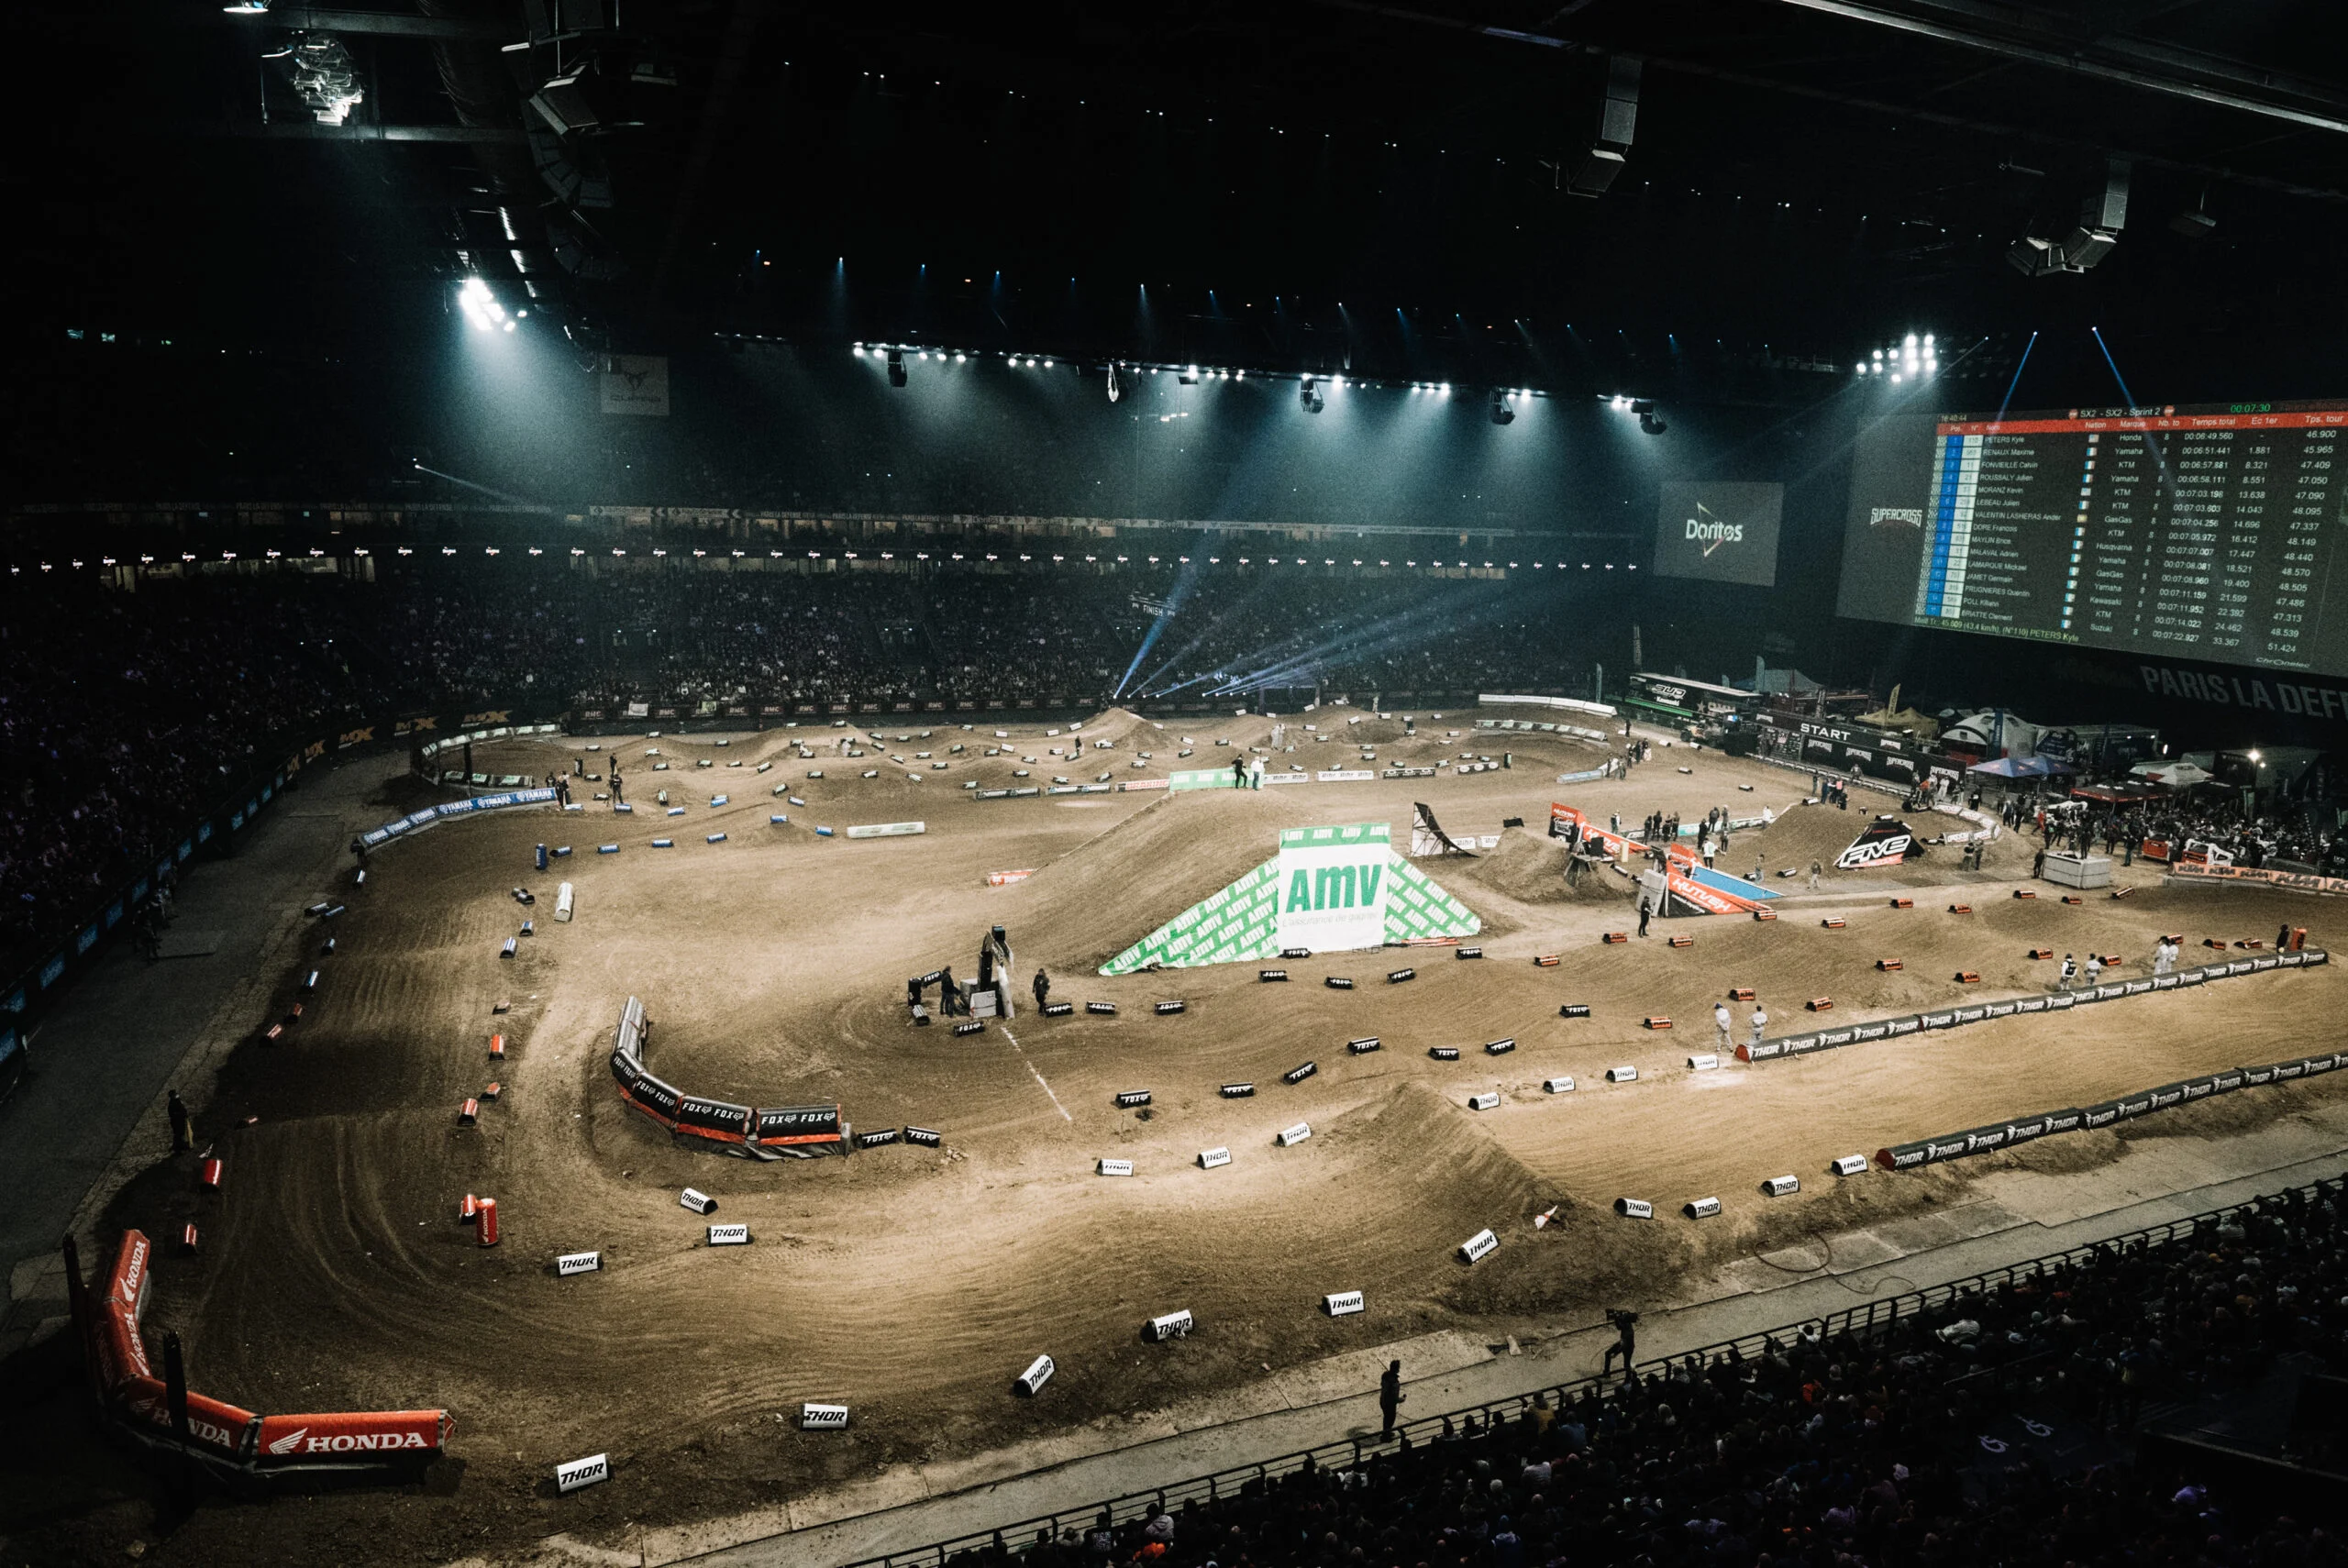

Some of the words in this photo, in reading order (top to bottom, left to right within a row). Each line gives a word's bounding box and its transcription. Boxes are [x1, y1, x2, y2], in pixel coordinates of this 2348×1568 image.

[1869, 507, 1923, 527] SUPERCROSS
[1685, 518, 1744, 542] Doritos
[2140, 666, 2232, 704] PARIS
[2232, 677, 2276, 712] LA
[1800, 723, 1851, 742] START
[525, 789, 553, 800] YAMAHA
[1752, 1043, 1780, 1058] THOR
[1790, 1037, 1816, 1051] THOR
[1825, 1032, 1851, 1045] THOR
[1860, 1026, 1885, 1039] THOR
[1893, 1020, 1919, 1033] THOR
[1928, 1014, 1952, 1027] THOR
[636, 1080, 649, 1092] FOX
[655, 1091, 669, 1104] FOX
[682, 1102, 703, 1113] FOX
[714, 1109, 735, 1120] FOX
[761, 1115, 786, 1125] FOX
[800, 1112, 825, 1123] FOX
[1895, 1151, 1924, 1167] THOR
[1935, 1142, 1965, 1157] THOR
[1977, 1132, 2004, 1147] THOR
[2016, 1123, 2042, 1139] THOR
[1776, 1180, 1797, 1191] THOR
[681, 1193, 703, 1209] THOR
[1628, 1202, 1650, 1213] THOR
[1697, 1201, 1719, 1214] THOR
[712, 1228, 746, 1239] THOR
[1470, 1234, 1494, 1255] THOR
[126, 1240, 147, 1288] HONDA
[561, 1256, 595, 1270] THOR
[1332, 1297, 1362, 1309] THOR
[1157, 1318, 1191, 1335] THOR
[1029, 1358, 1051, 1387] THOR
[804, 1410, 846, 1422] THOR
[151, 1407, 232, 1448] HNDA
[305, 1431, 427, 1453] HONDA
[560, 1463, 605, 1485] THOR
